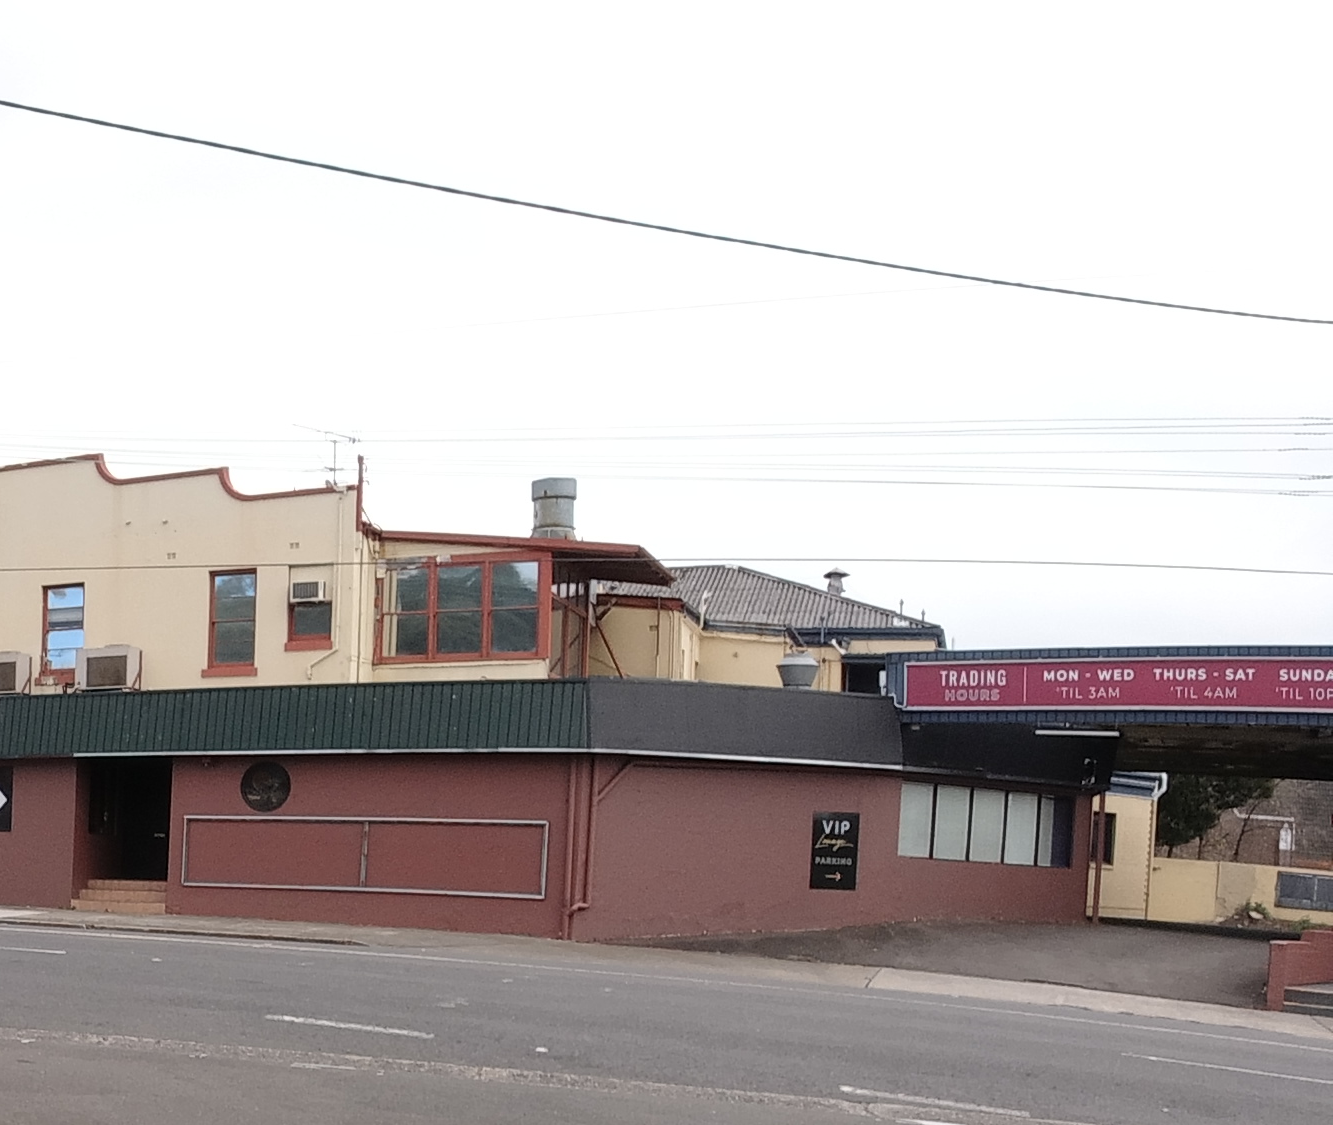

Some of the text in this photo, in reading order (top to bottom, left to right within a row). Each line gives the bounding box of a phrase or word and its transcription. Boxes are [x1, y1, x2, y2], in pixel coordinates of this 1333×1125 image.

[940, 669, 1007, 687] TRADING
[1043, 669, 1079, 682] MON
[1098, 669, 1135, 681] WED
[1153, 668, 1207, 681] THURS
[1225, 668, 1256, 681] SAT
[944, 689, 1000, 702] HOURS
[1089, 687, 1120, 699] 3AM
[1204, 687, 1237, 699] 4AM
[822, 820, 851, 835] VIP
[815, 857, 852, 866] PARKING
